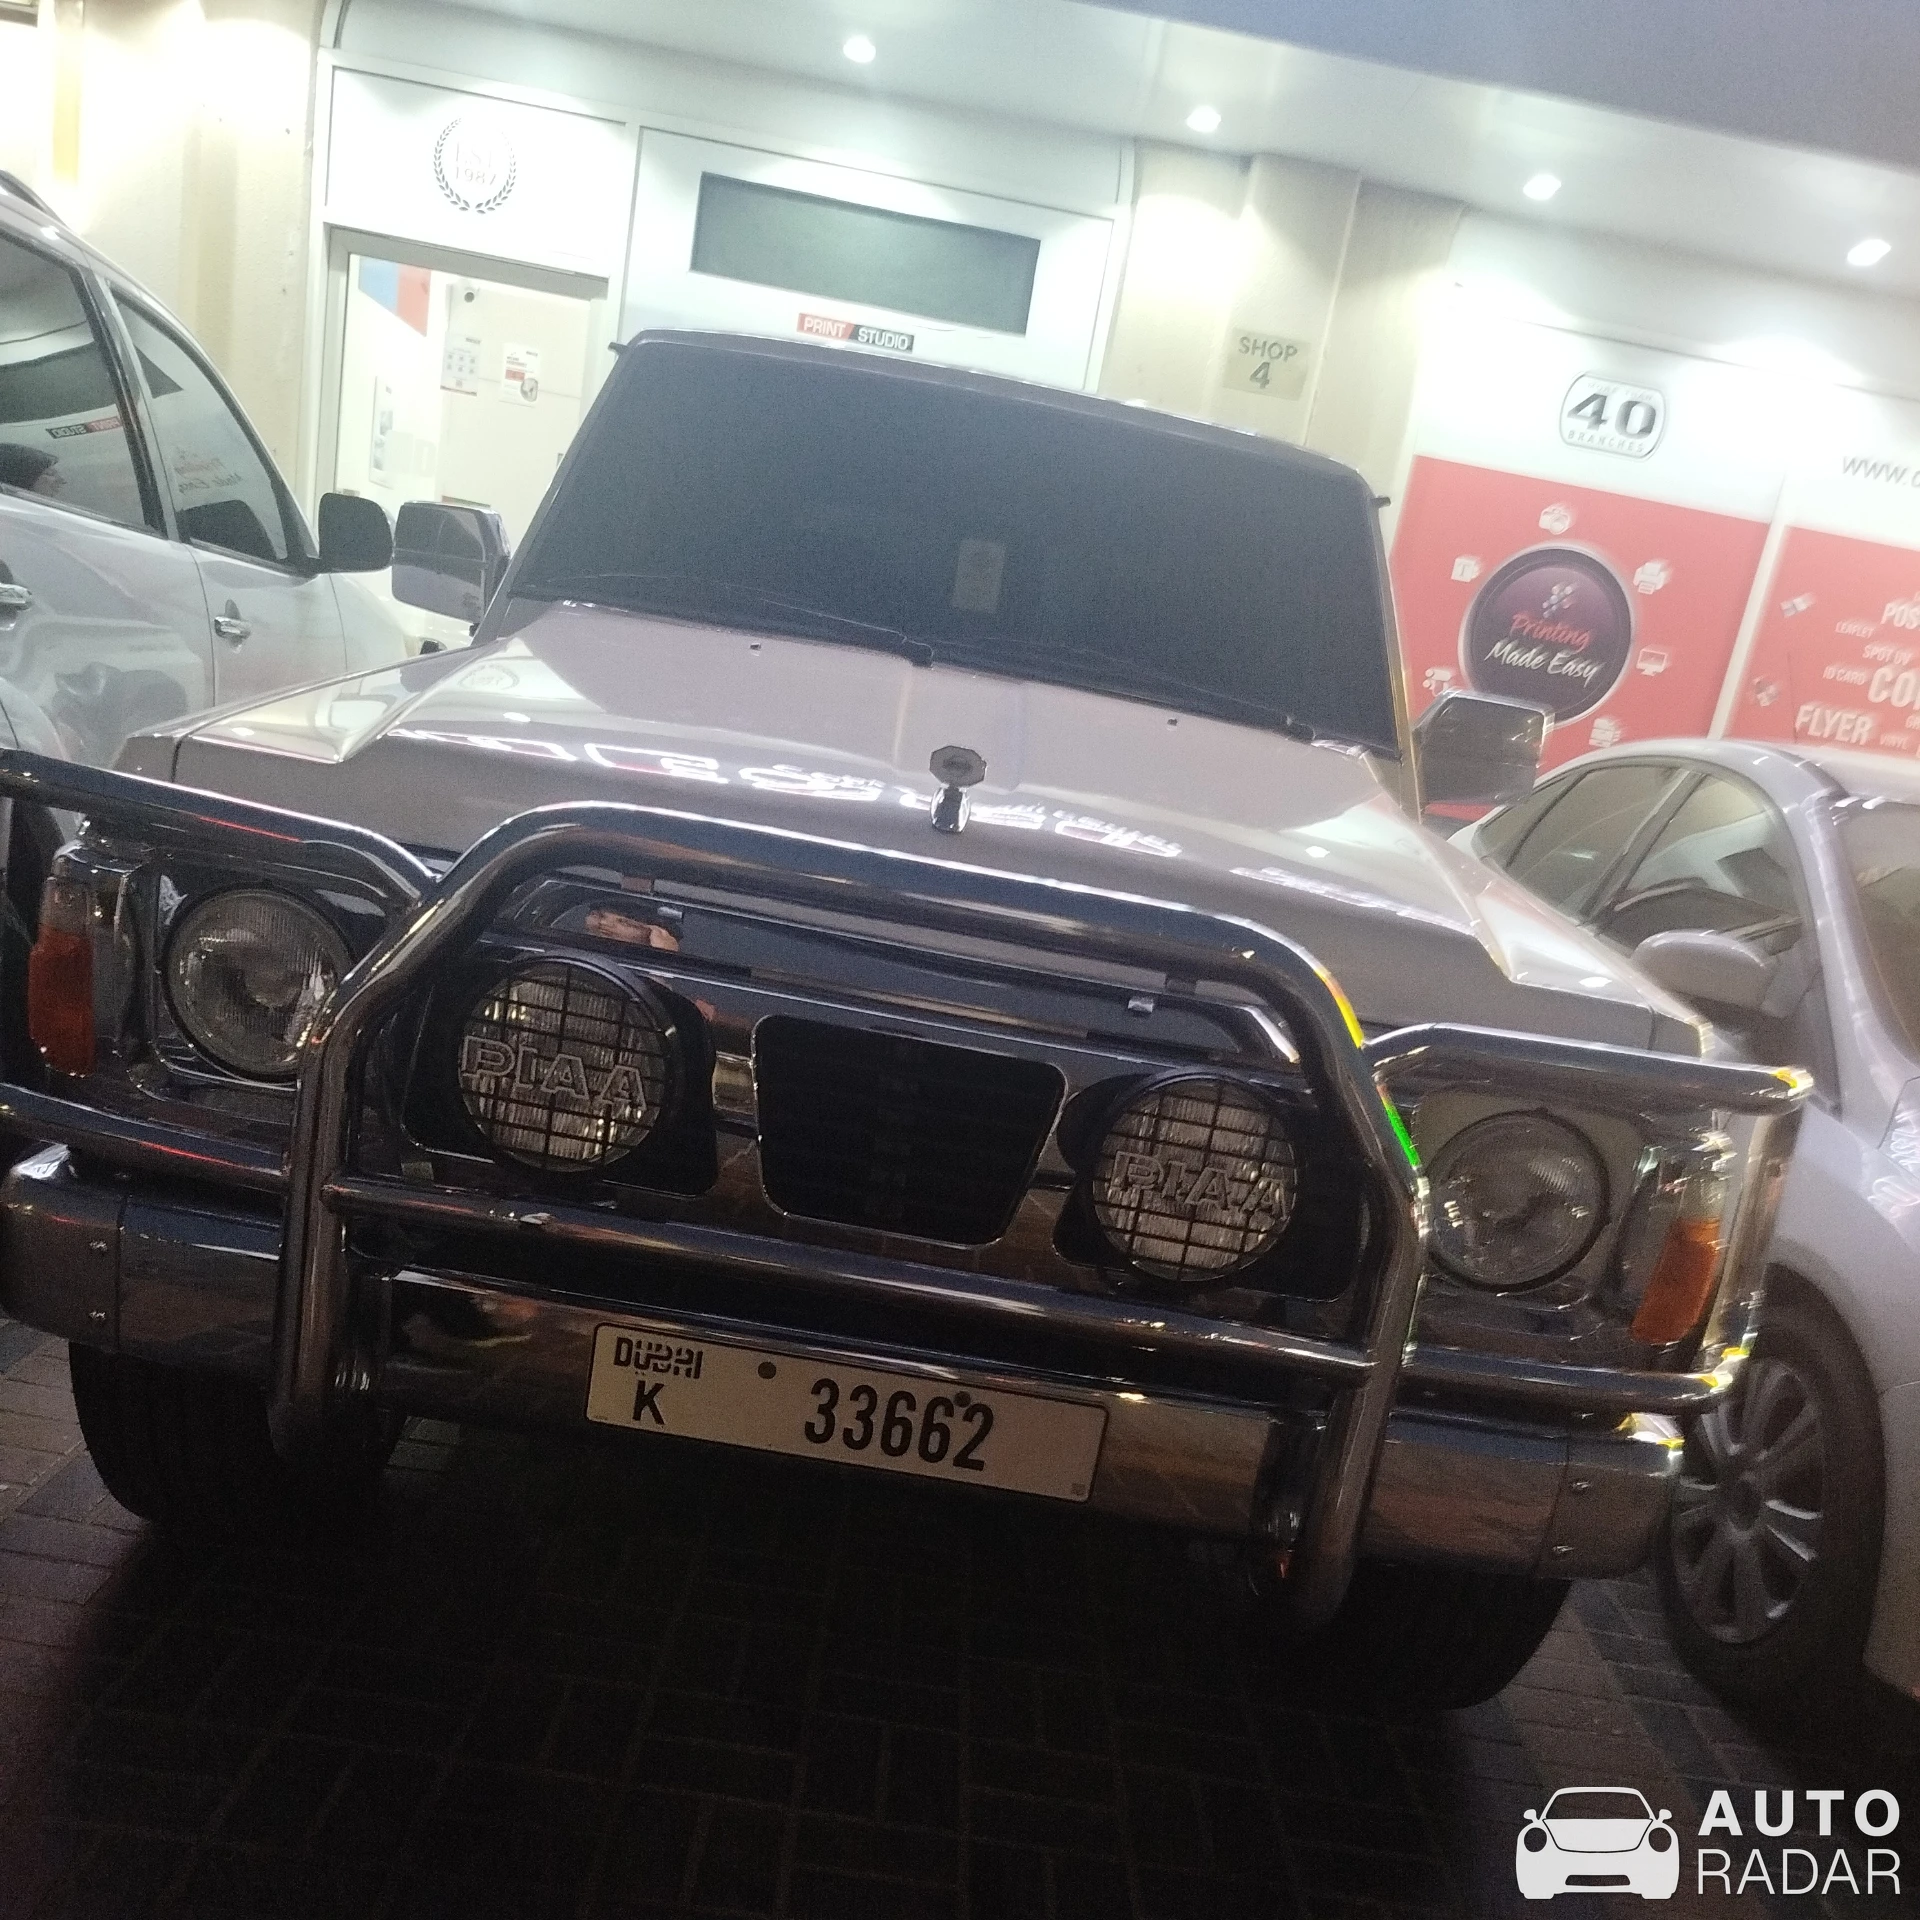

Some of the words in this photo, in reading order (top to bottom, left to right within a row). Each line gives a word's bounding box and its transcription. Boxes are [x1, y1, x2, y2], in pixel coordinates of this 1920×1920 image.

[803, 317, 847, 338] PRINT
[857, 327, 909, 351] STUDIO
[1238, 336, 1298, 362] SHOP
[1249, 361, 1270, 389] 4
[1566, 393, 1657, 440] 40
[1567, 430, 1645, 453] BRANCHES
[1510, 612, 1592, 655] Printing
[1835, 621, 1874, 639] LEAFLET
[1880, 602, 1920, 631] POS
[1484, 638, 1547, 670] Made
[1547, 651, 1605, 688] Easy
[1862, 644, 1894, 662] SPOT
[1822, 665, 1836, 680] ID
[1836, 669, 1866, 686] CARD
[1795, 704, 1872, 746] FLYER
[461, 1035, 648, 1112] PIAA
[1107, 1150, 1288, 1222] PIAA
[632, 1379, 666, 1426] K
[803, 1377, 995, 1473] 33662
